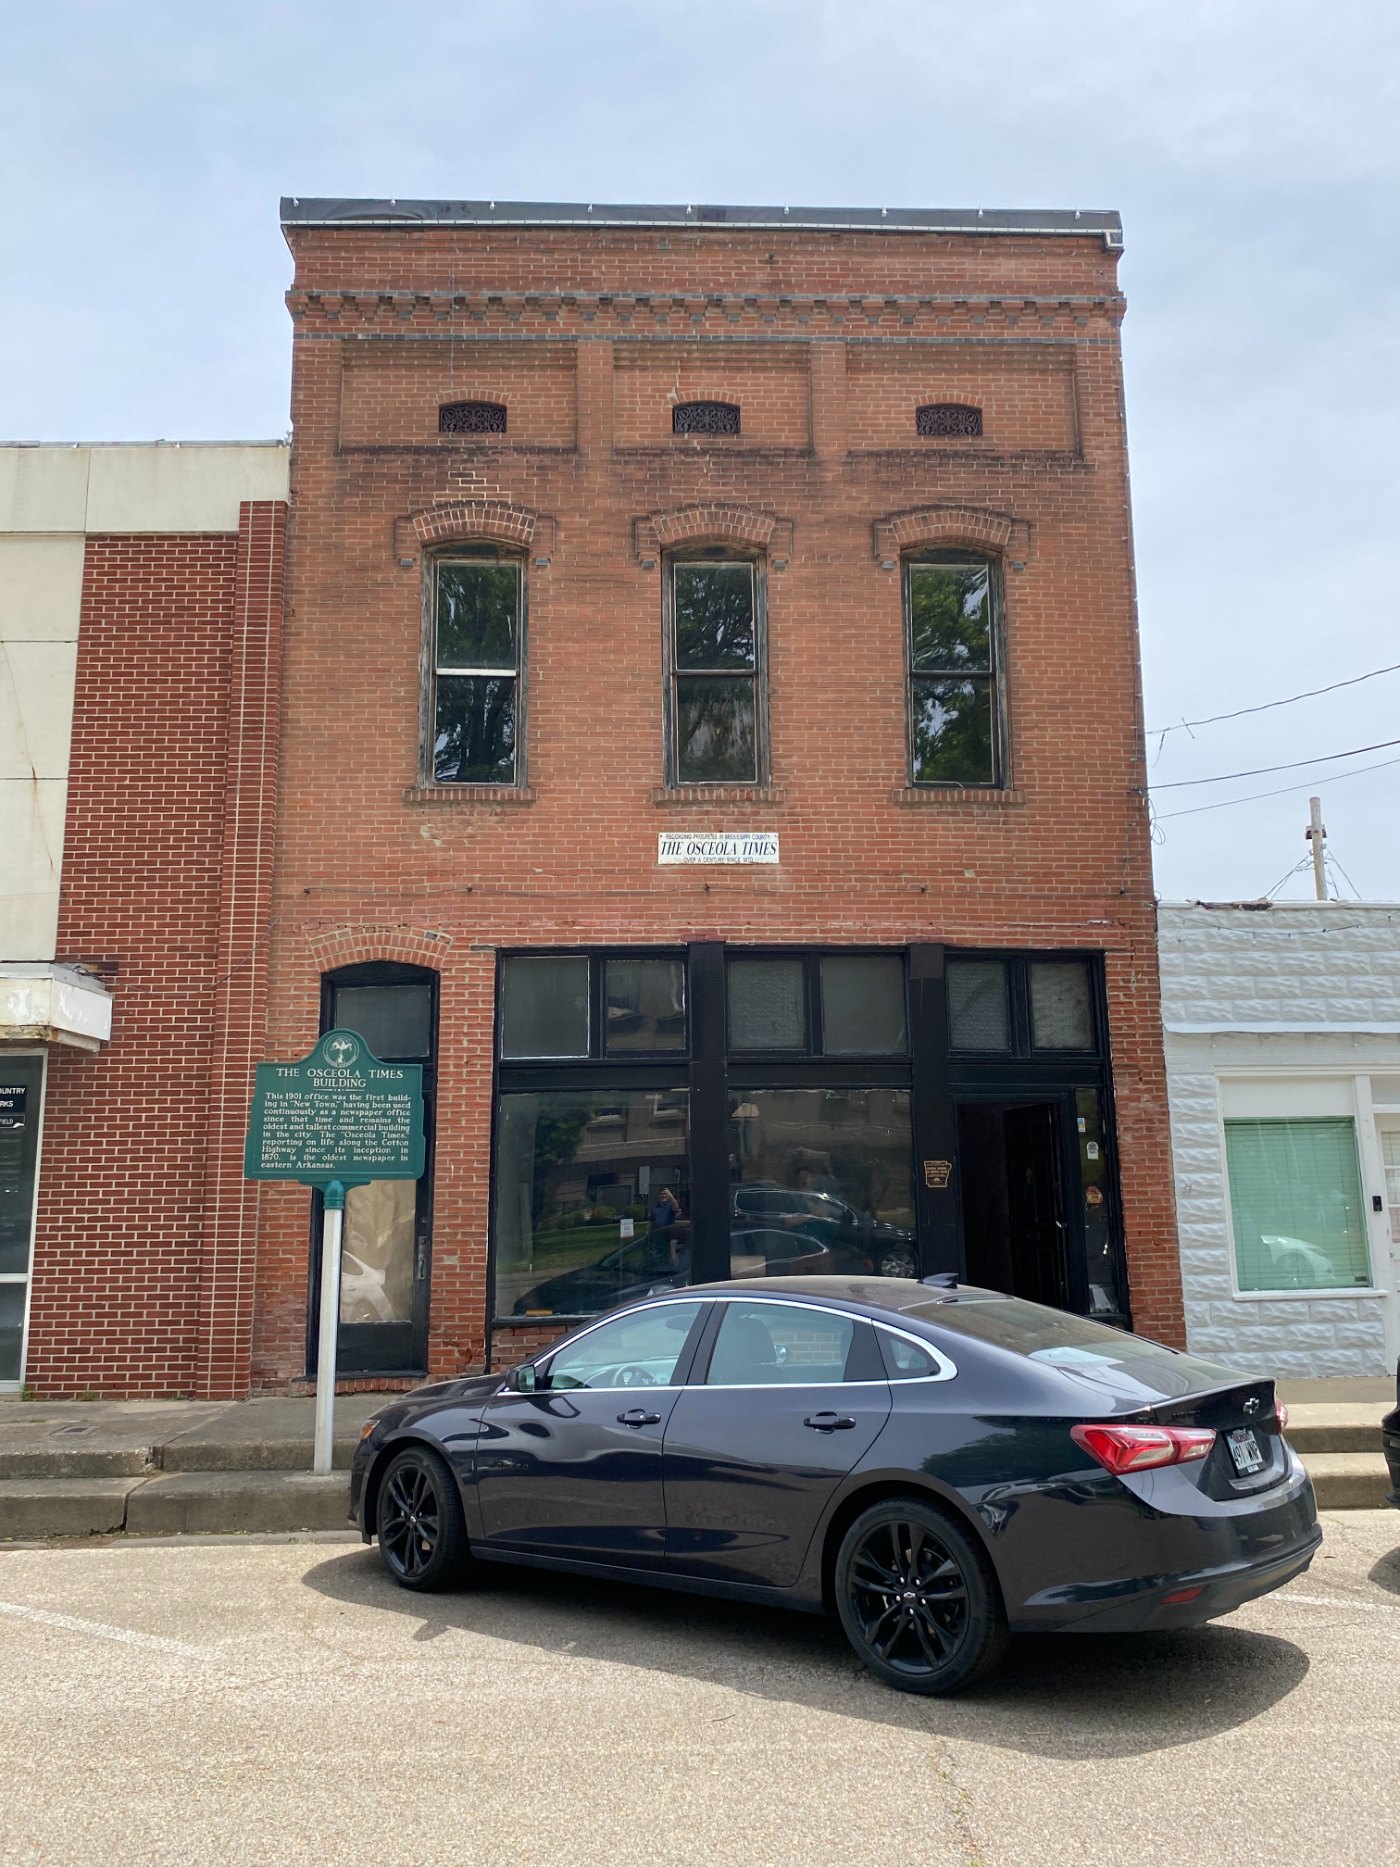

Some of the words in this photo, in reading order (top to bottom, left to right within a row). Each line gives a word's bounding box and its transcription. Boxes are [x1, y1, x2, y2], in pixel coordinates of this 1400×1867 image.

[661, 841, 684, 855] THE
[687, 841, 736, 855] OSCEOLA
[743, 841, 777, 855] TIMES
[276, 1068, 300, 1077] THE
[307, 1068, 361, 1078] OSCEOLA
[368, 1069, 404, 1079] TIMES
[313, 1078, 366, 1088] BUILDING
[265, 1092, 283, 1100] This
[264, 1100, 277, 1108] ing
[343, 1101, 370, 1109] having
[306, 1123, 331, 1131] tallest
[378, 1124, 410, 1132] building
[261, 1146, 297, 1154] Highway
[296, 1161, 335, 1169] Arkansas.
